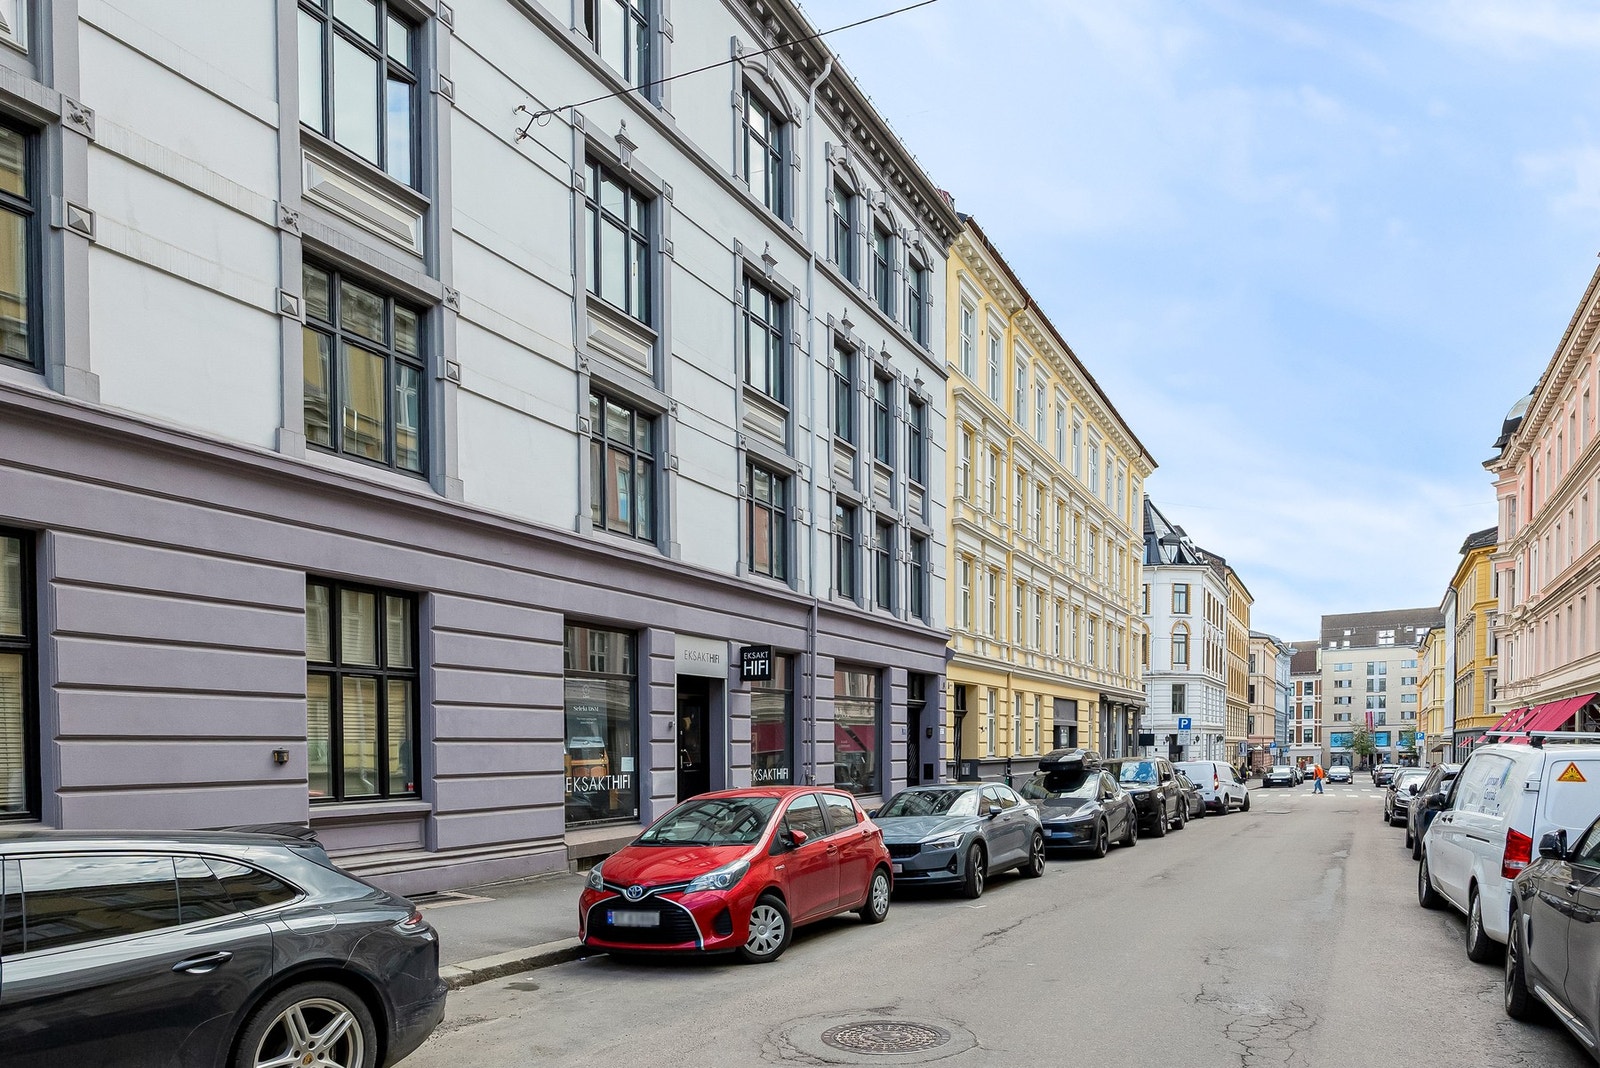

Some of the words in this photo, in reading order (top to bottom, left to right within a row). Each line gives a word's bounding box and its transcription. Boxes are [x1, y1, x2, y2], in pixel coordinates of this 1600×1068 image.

[744, 651, 769, 660] EKSAKT
[744, 660, 769, 676] HIFI
[1181, 719, 1189, 729] P
[750, 767, 789, 782] KSAKTHIFI
[566, 774, 631, 793] EKSAKTHIFI
